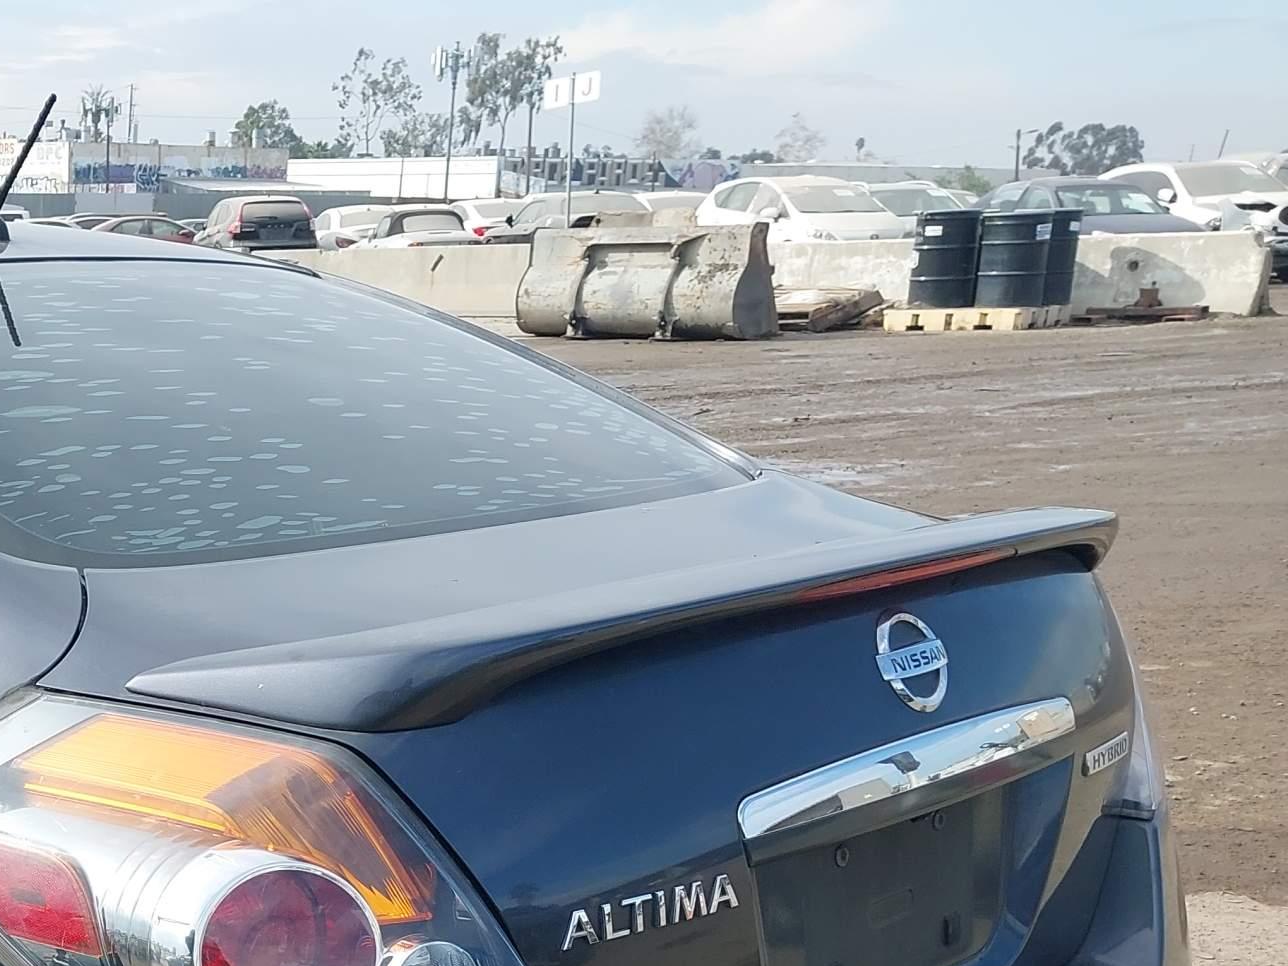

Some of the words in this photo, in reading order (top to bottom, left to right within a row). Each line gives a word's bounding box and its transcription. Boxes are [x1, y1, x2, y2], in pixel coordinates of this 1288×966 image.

[582, 76, 592, 96] J
[890, 645, 946, 674] NISSAN
[1092, 738, 1128, 770] HYBRID
[561, 872, 740, 952] ALTIMA
